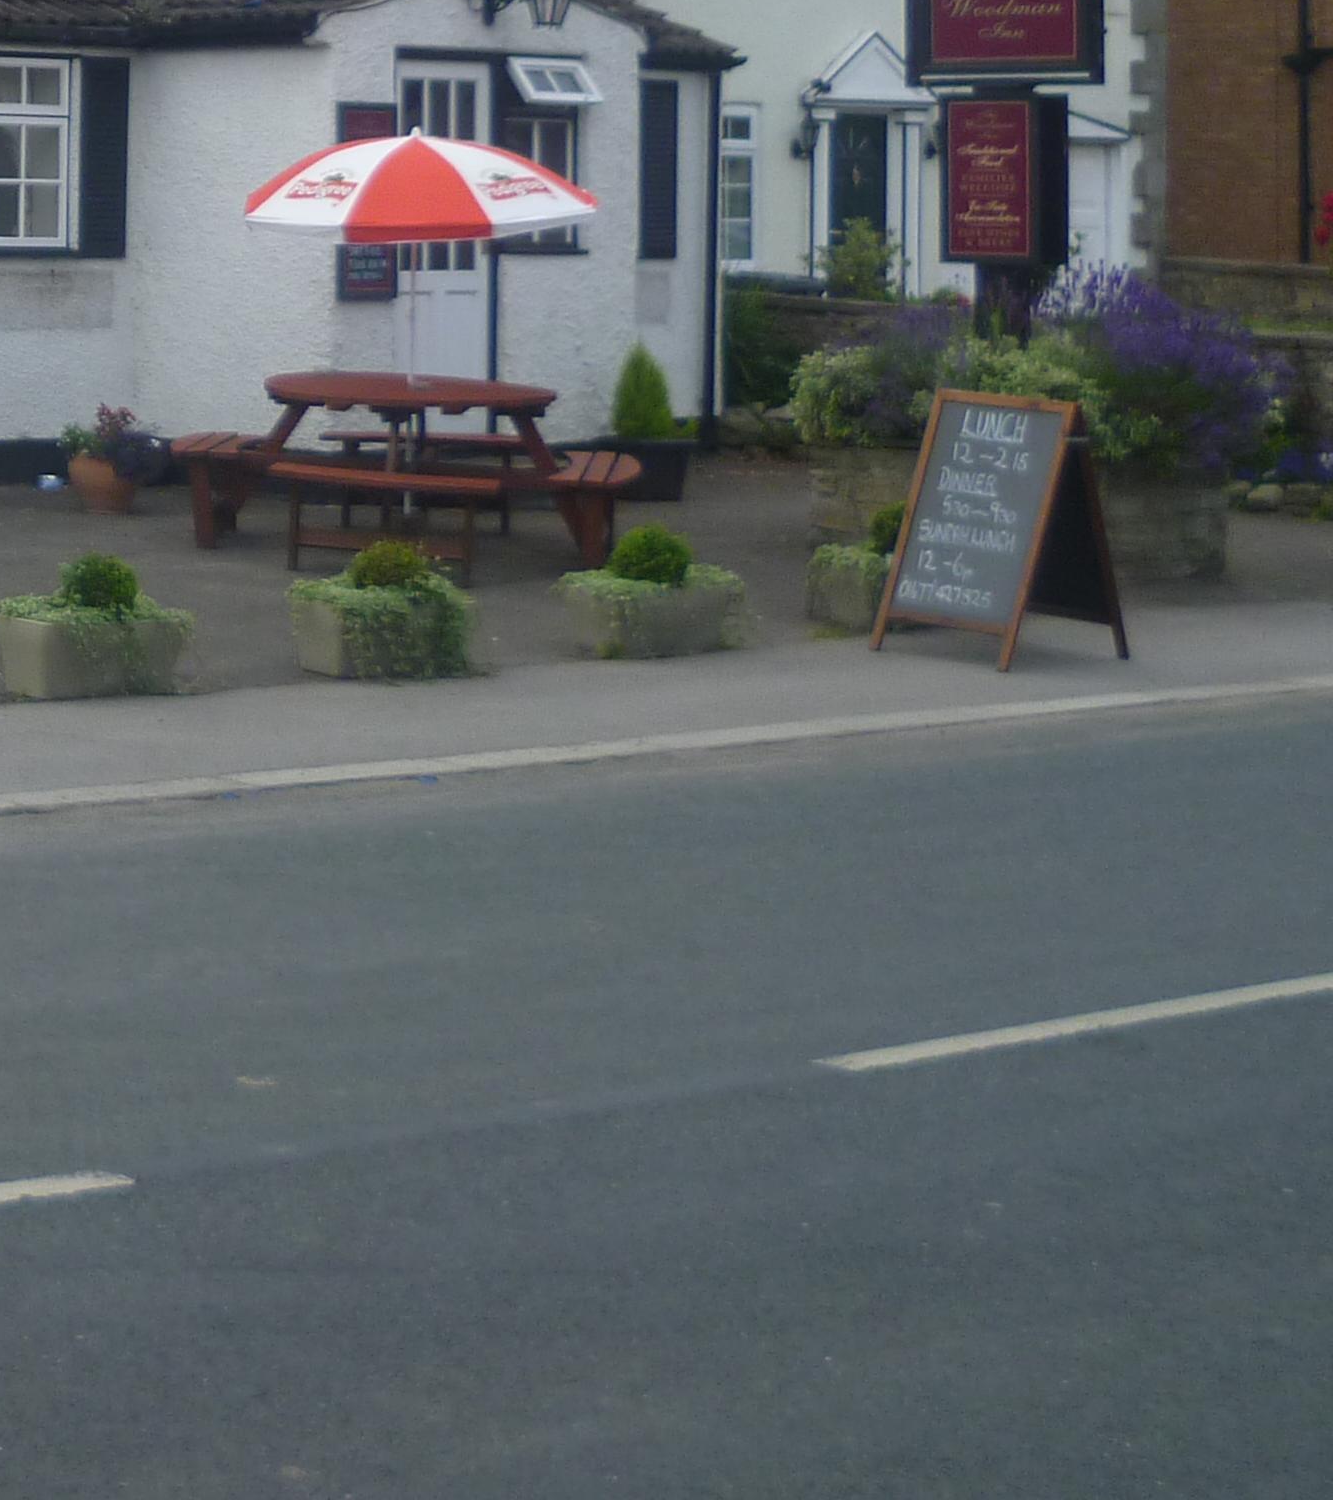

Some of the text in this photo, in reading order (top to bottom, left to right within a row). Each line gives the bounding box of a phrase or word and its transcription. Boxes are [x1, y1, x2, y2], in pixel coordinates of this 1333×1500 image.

[977, 19, 1026, 40] Inn
[960, 408, 1030, 443] LUNCH
[952, 441, 974, 464] 12
[937, 465, 998, 497] DINNER
[971, 526, 1016, 553] LUNCH
[917, 549, 937, 571] 12
